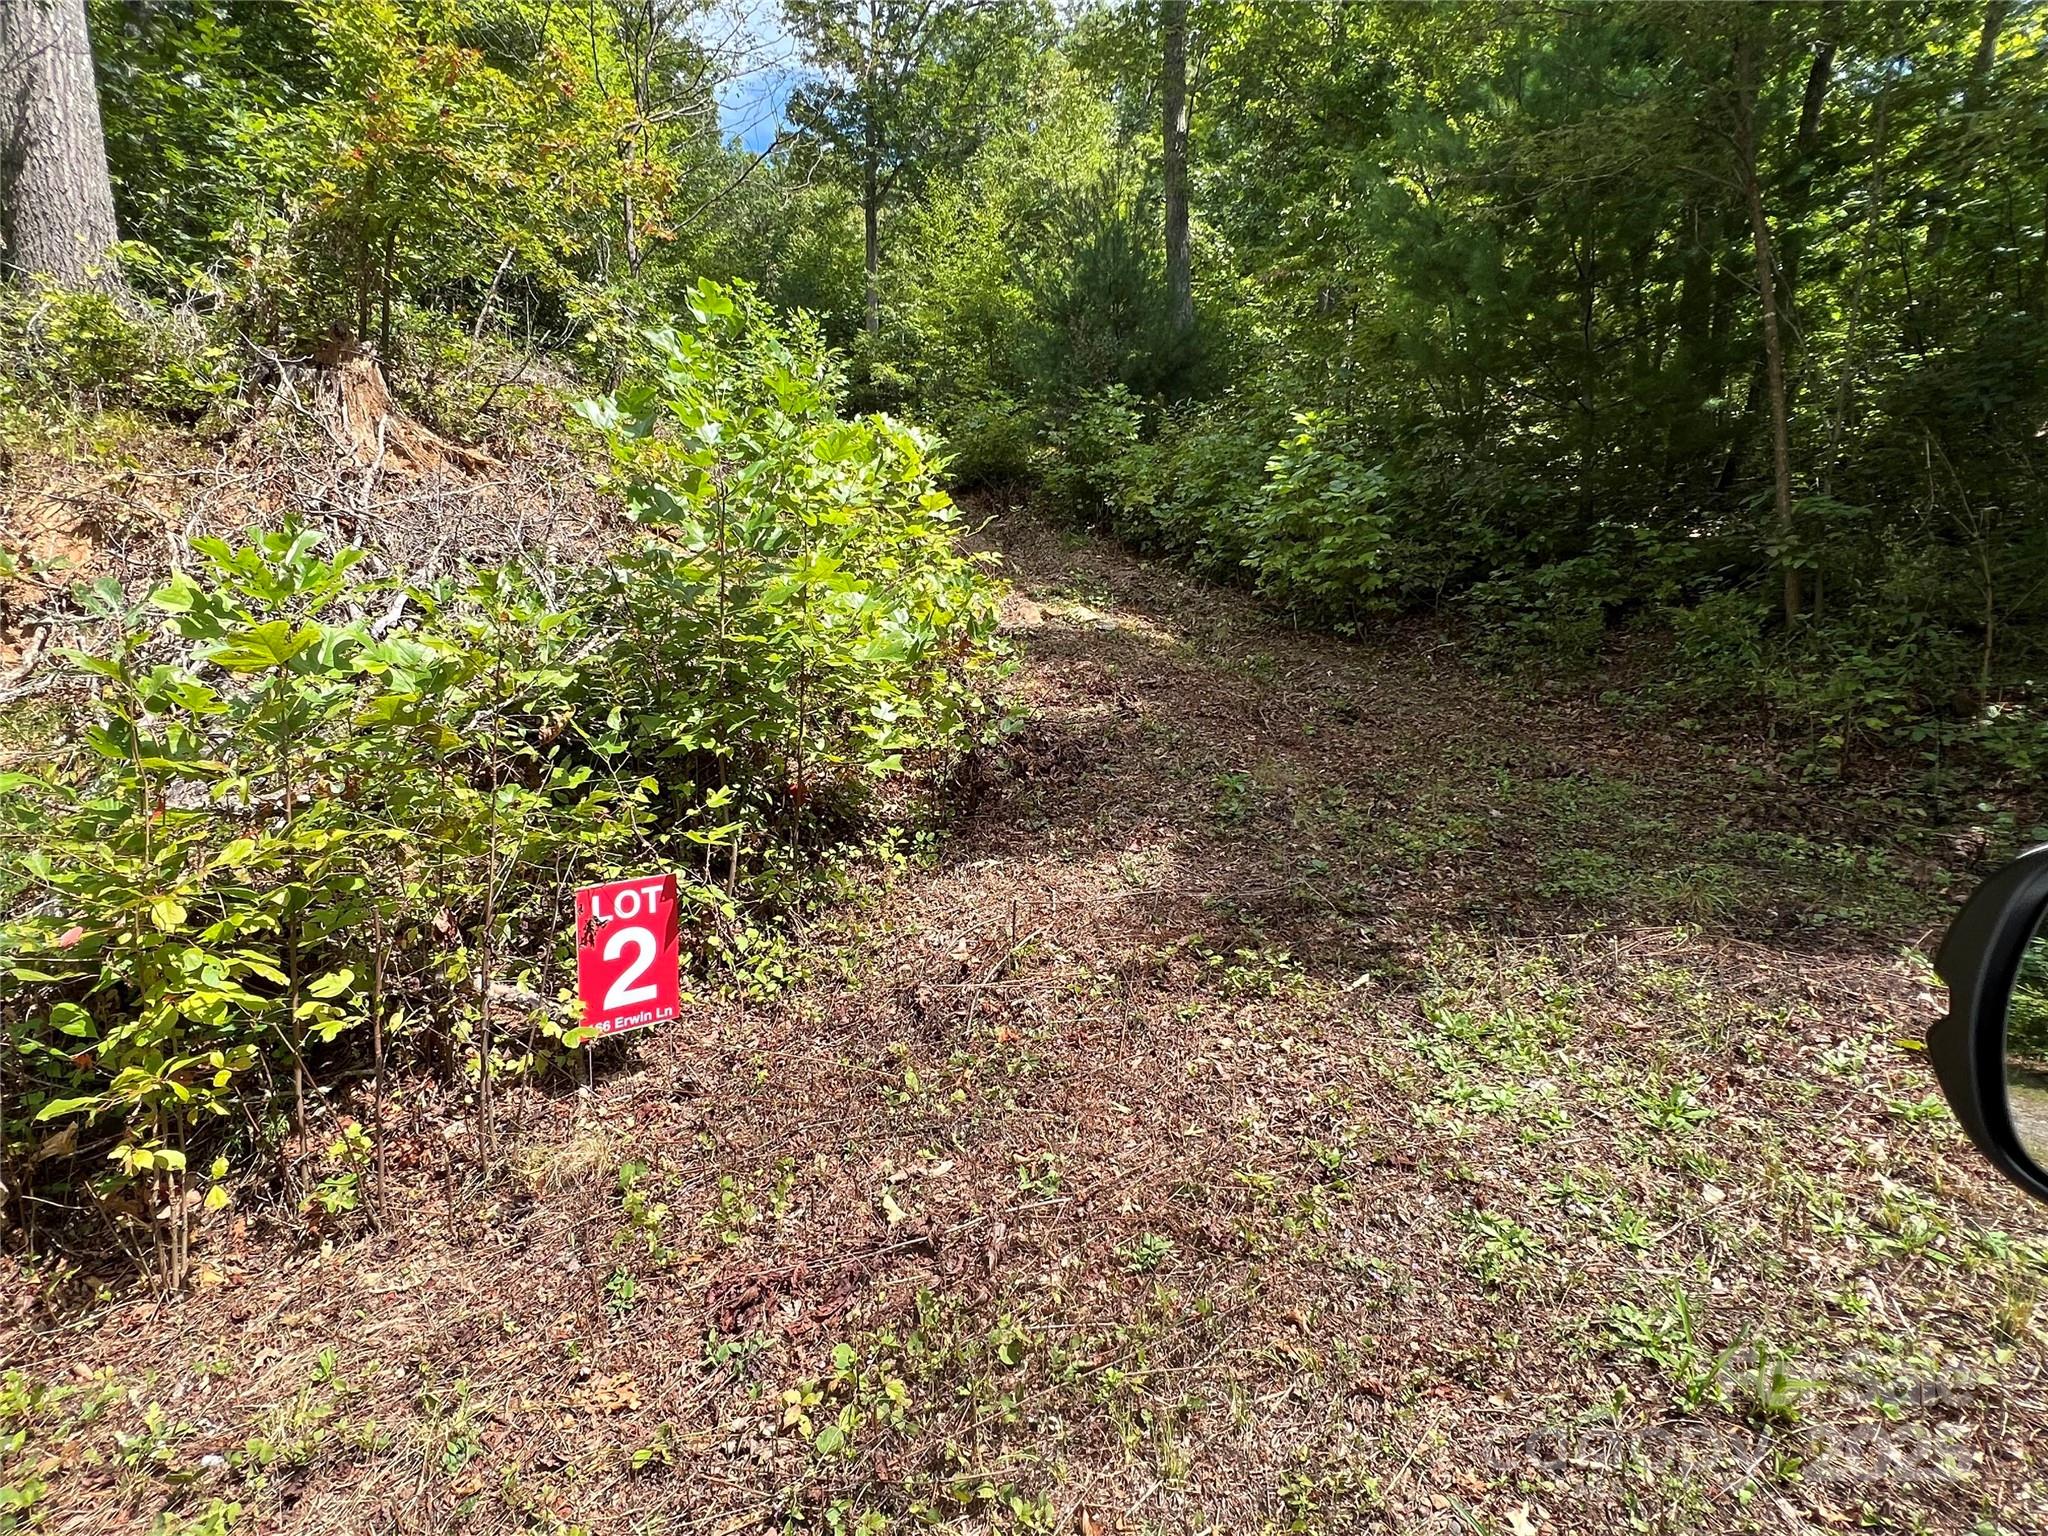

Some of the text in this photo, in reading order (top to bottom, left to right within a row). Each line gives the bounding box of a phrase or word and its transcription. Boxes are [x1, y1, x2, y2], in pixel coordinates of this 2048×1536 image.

[591, 885, 664, 922] LOT
[603, 926, 657, 1011] 2
[590, 1006, 673, 1032] 66 Erwin Ln
